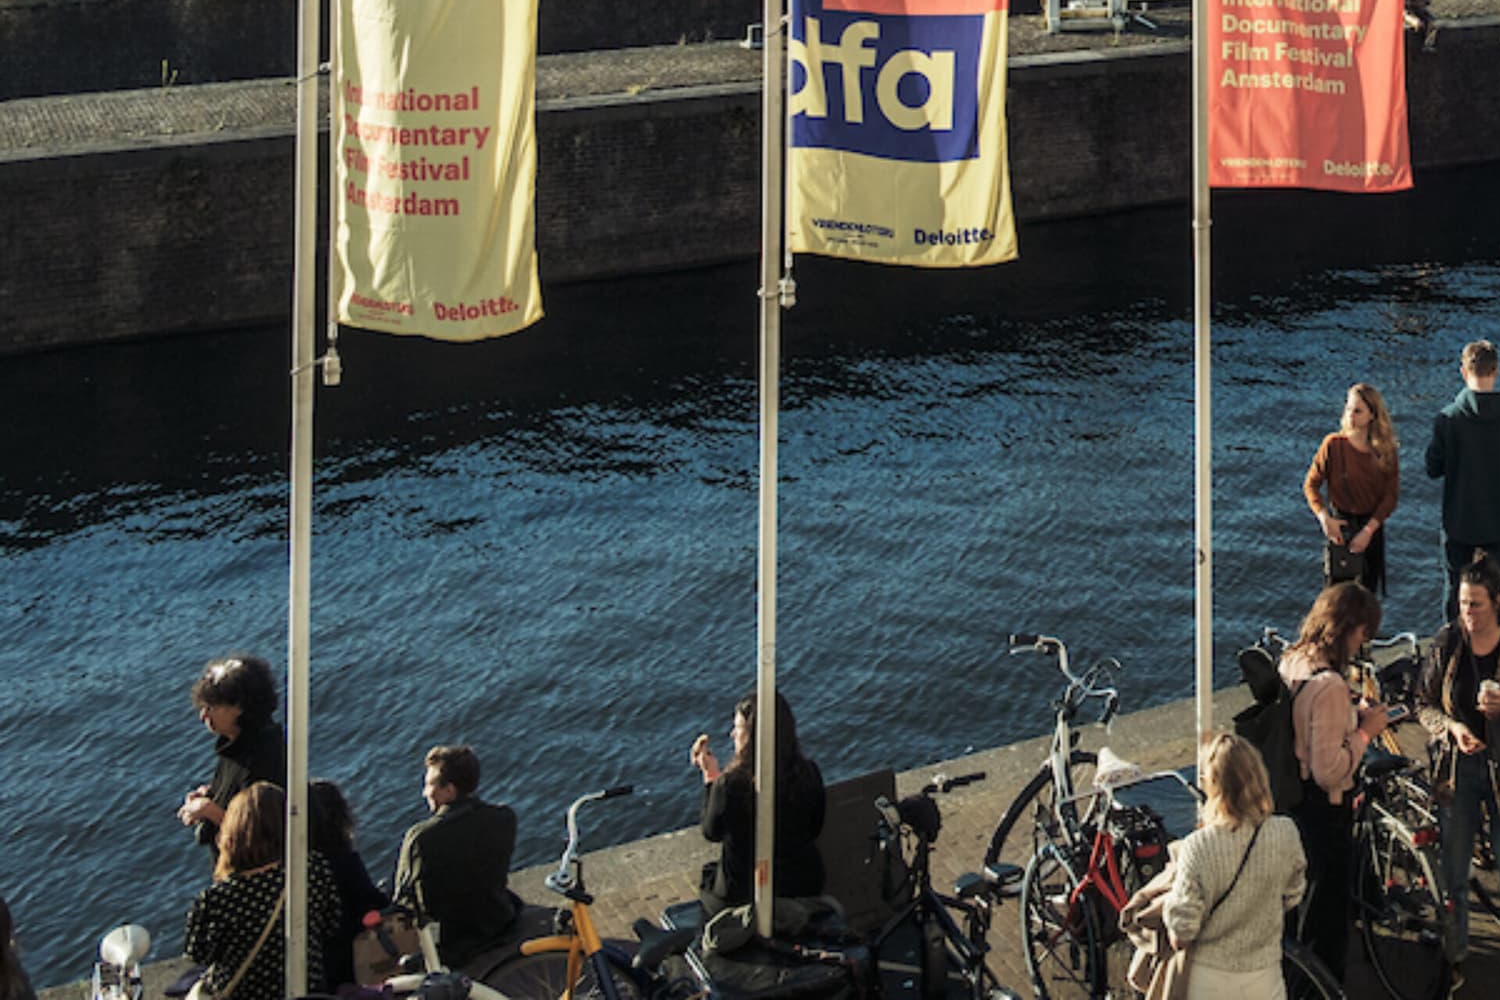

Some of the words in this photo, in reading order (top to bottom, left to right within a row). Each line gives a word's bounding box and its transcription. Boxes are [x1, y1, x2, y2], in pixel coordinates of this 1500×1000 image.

[1221, 14, 1366, 43] Documentary
[1221, 41, 1269, 61] Film
[1275, 42, 1353, 68] Festival
[1220, 69, 1345, 94] Amsterdam
[346, 80, 480, 112] Innational
[914, 227, 995, 246] Deloitte.
